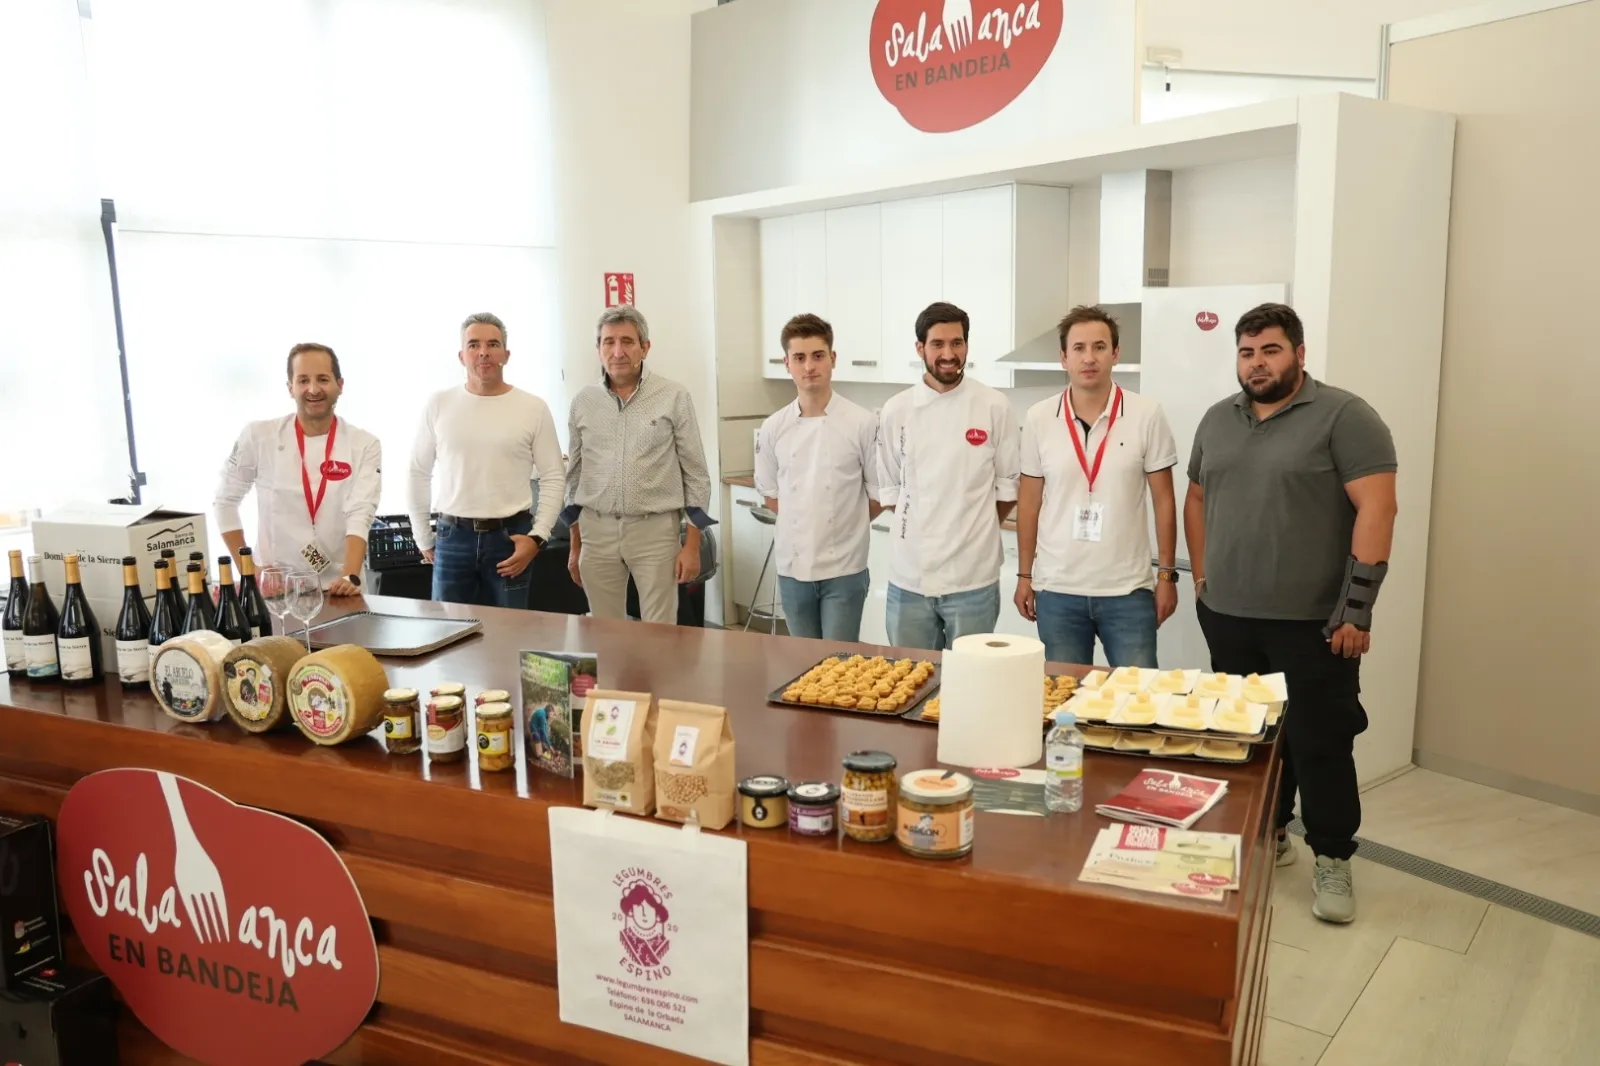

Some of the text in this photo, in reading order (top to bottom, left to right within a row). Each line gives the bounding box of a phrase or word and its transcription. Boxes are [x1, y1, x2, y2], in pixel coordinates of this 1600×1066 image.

[896, 52, 1012, 91] EN BANDEJA
[147, 536, 196, 552] Salamanca
[88, 554, 95, 563] la
[97, 555, 121, 565] Sierra
[612, 867, 673, 900] LEGUMBRES
[612, 911, 623, 921] 20
[667, 923, 678, 933] 20
[109, 933, 146, 968] EN
[157, 946, 300, 1013] BANDEJA
[619, 957, 672, 981] ESPINO
[595, 973, 699, 1004] www.legumbresespino.com
[607, 986, 640, 1002] Teléfono:
[656, 1000, 671, 1011] 006
[673, 1004, 687, 1014] 521
[609, 999, 684, 1025] Espino de la Orbada
[623, 1013, 671, 1032] SALAMANCA
